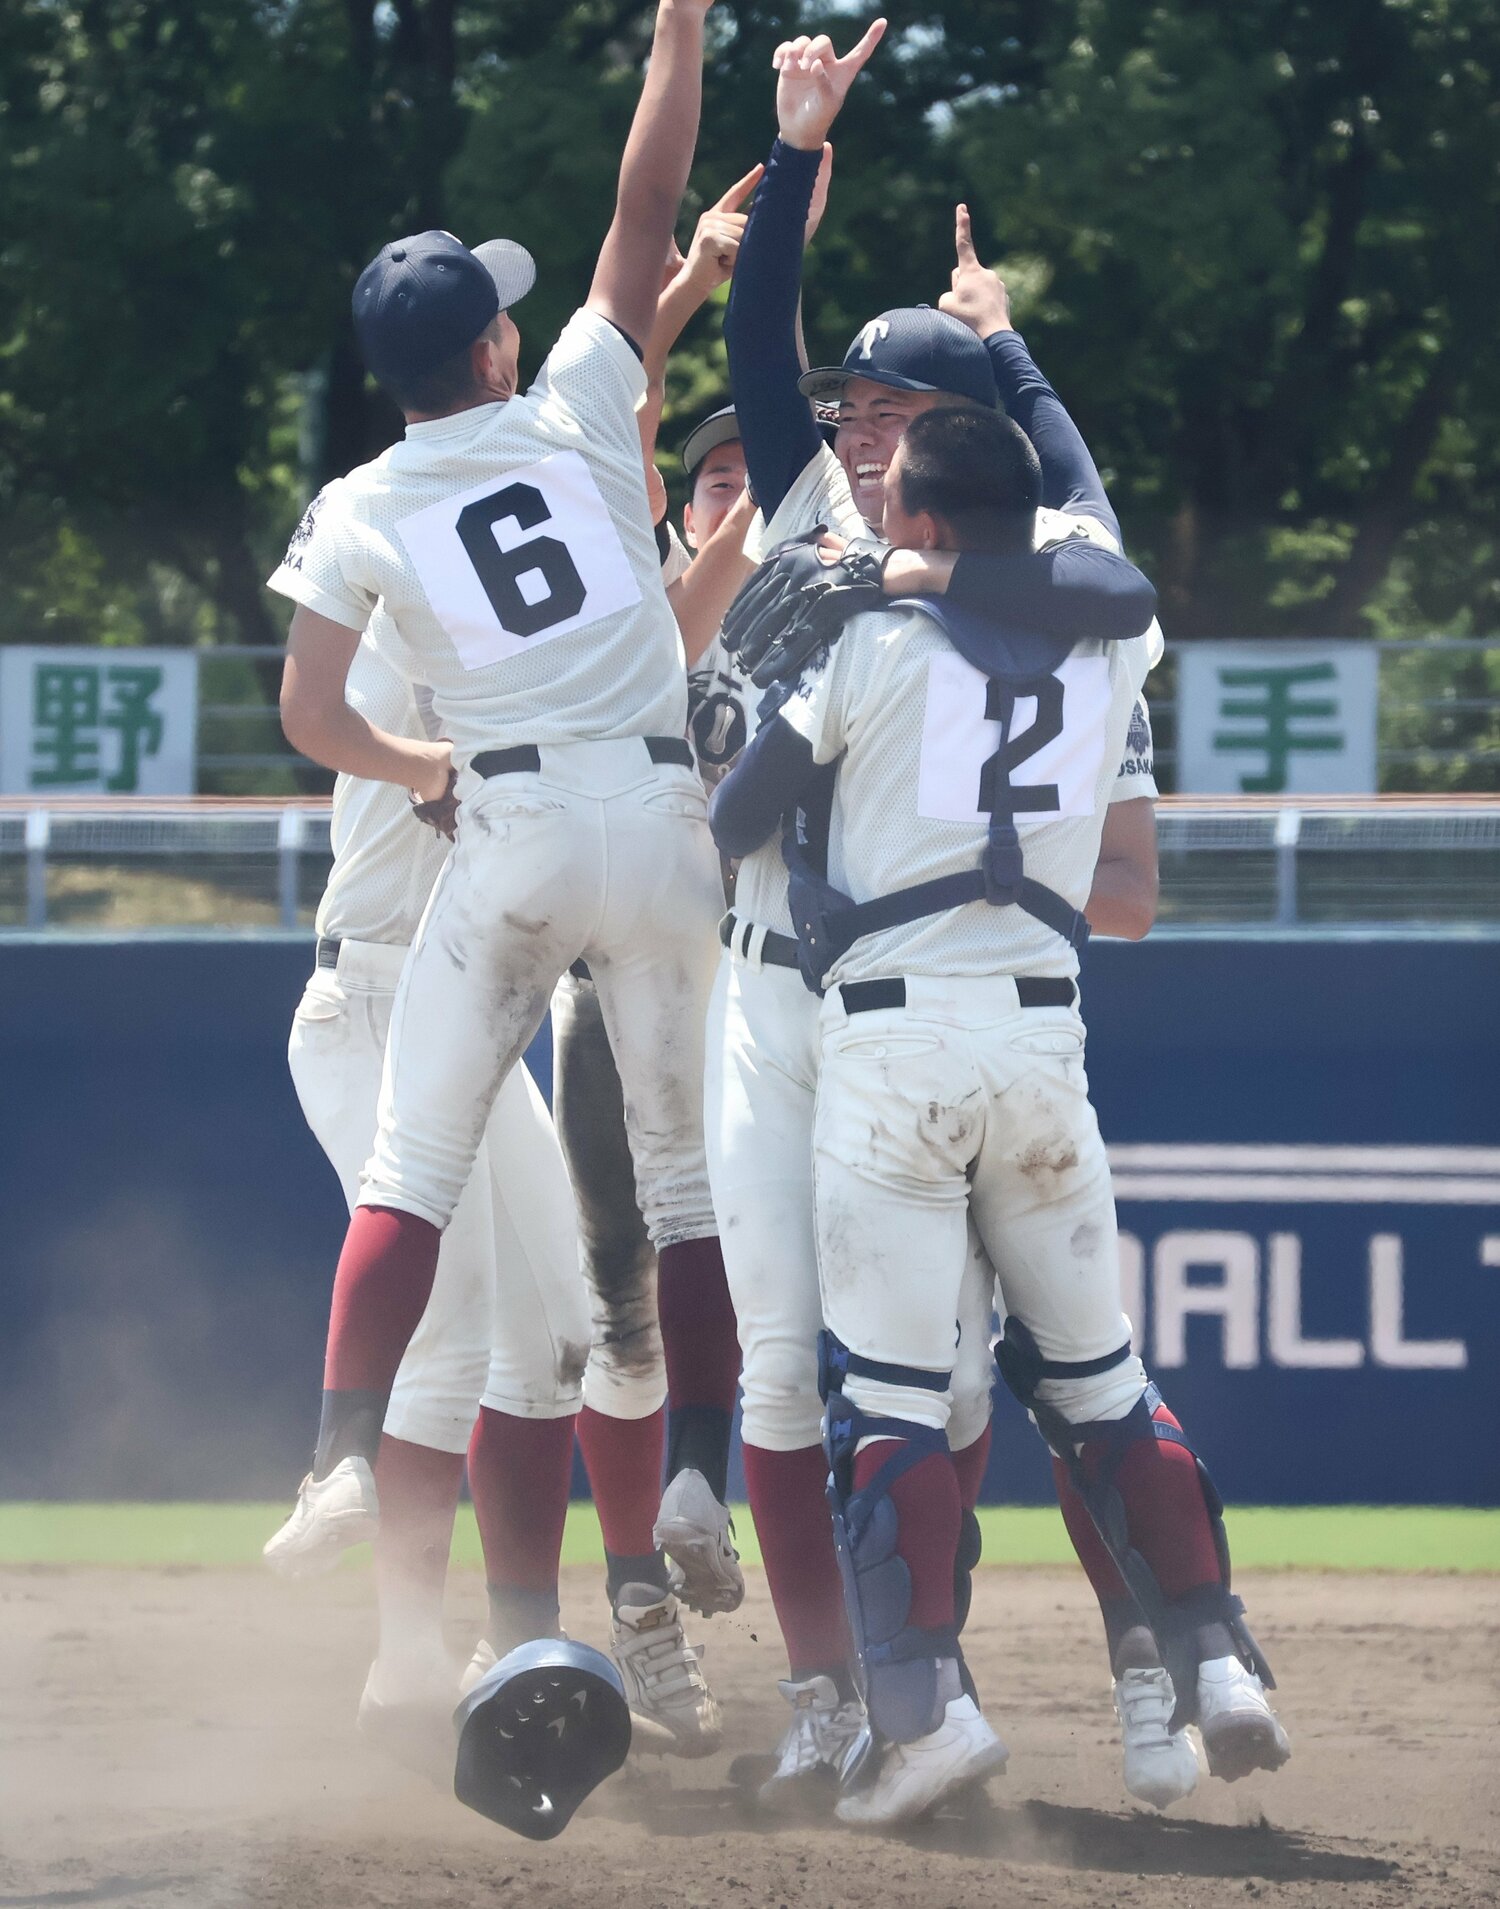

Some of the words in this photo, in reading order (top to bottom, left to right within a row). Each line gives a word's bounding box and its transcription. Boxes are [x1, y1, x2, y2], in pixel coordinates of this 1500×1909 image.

[859, 318, 890, 360] T
[283, 551, 303, 572] KA
[455, 481, 587, 638] 6
[30, 662, 163, 792] 野
[977, 672, 1065, 813] 2
[1117, 757, 1154, 778] SAK
[1212, 662, 1345, 793] 手
